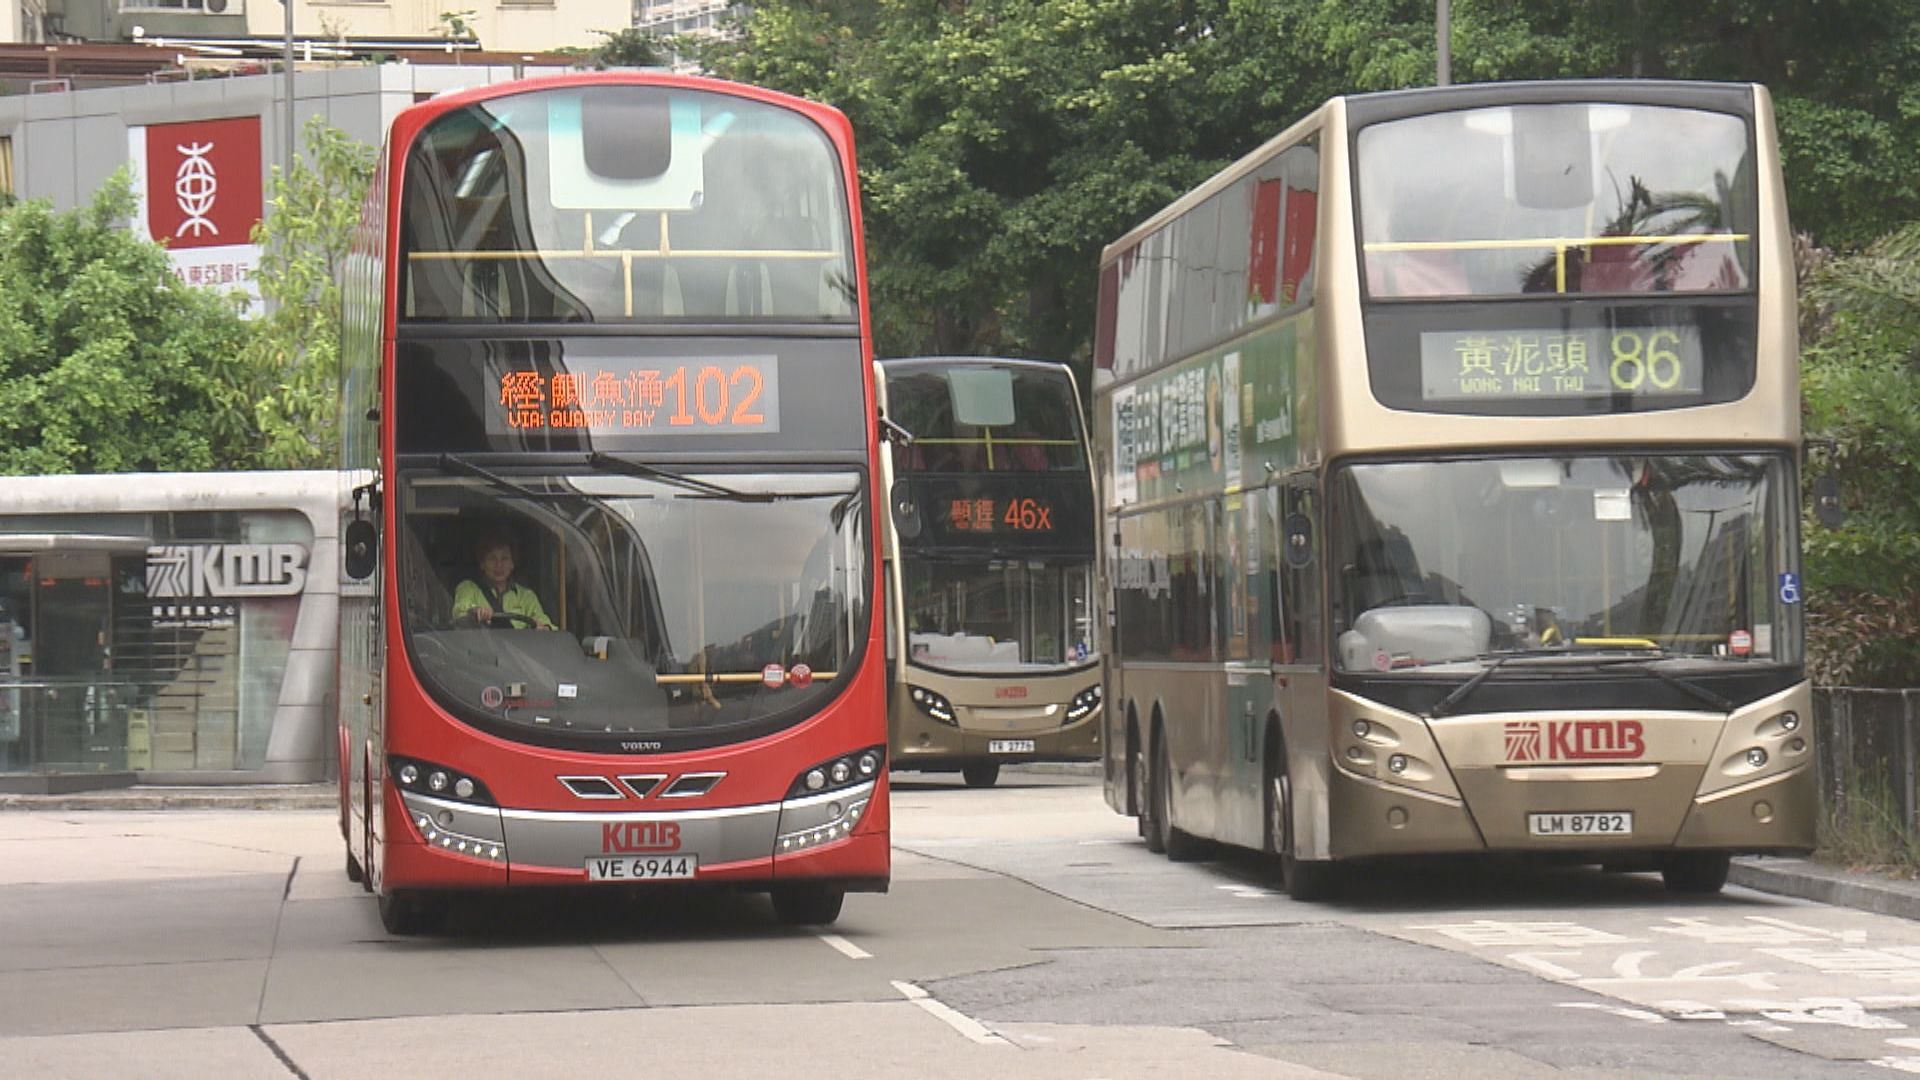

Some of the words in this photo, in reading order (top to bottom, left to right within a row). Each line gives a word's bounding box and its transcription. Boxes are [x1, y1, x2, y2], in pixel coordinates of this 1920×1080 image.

[1455, 335, 1589, 377] 黃泥頭
[1610, 331, 1681, 390] 86
[1460, 376, 1502, 394] WONG
[1554, 375, 1584, 392] TAU
[665, 365, 765, 427] 102
[508, 410, 545, 428] VIA:
[550, 410, 616, 428] QUARRY
[623, 409, 656, 427] BAY
[620, 741, 662, 750] VOLVO
[1537, 817, 1564, 833] LM
[1571, 815, 1624, 832] 8782
[597, 859, 624, 878] VE
[632, 858, 688, 878] 6944
